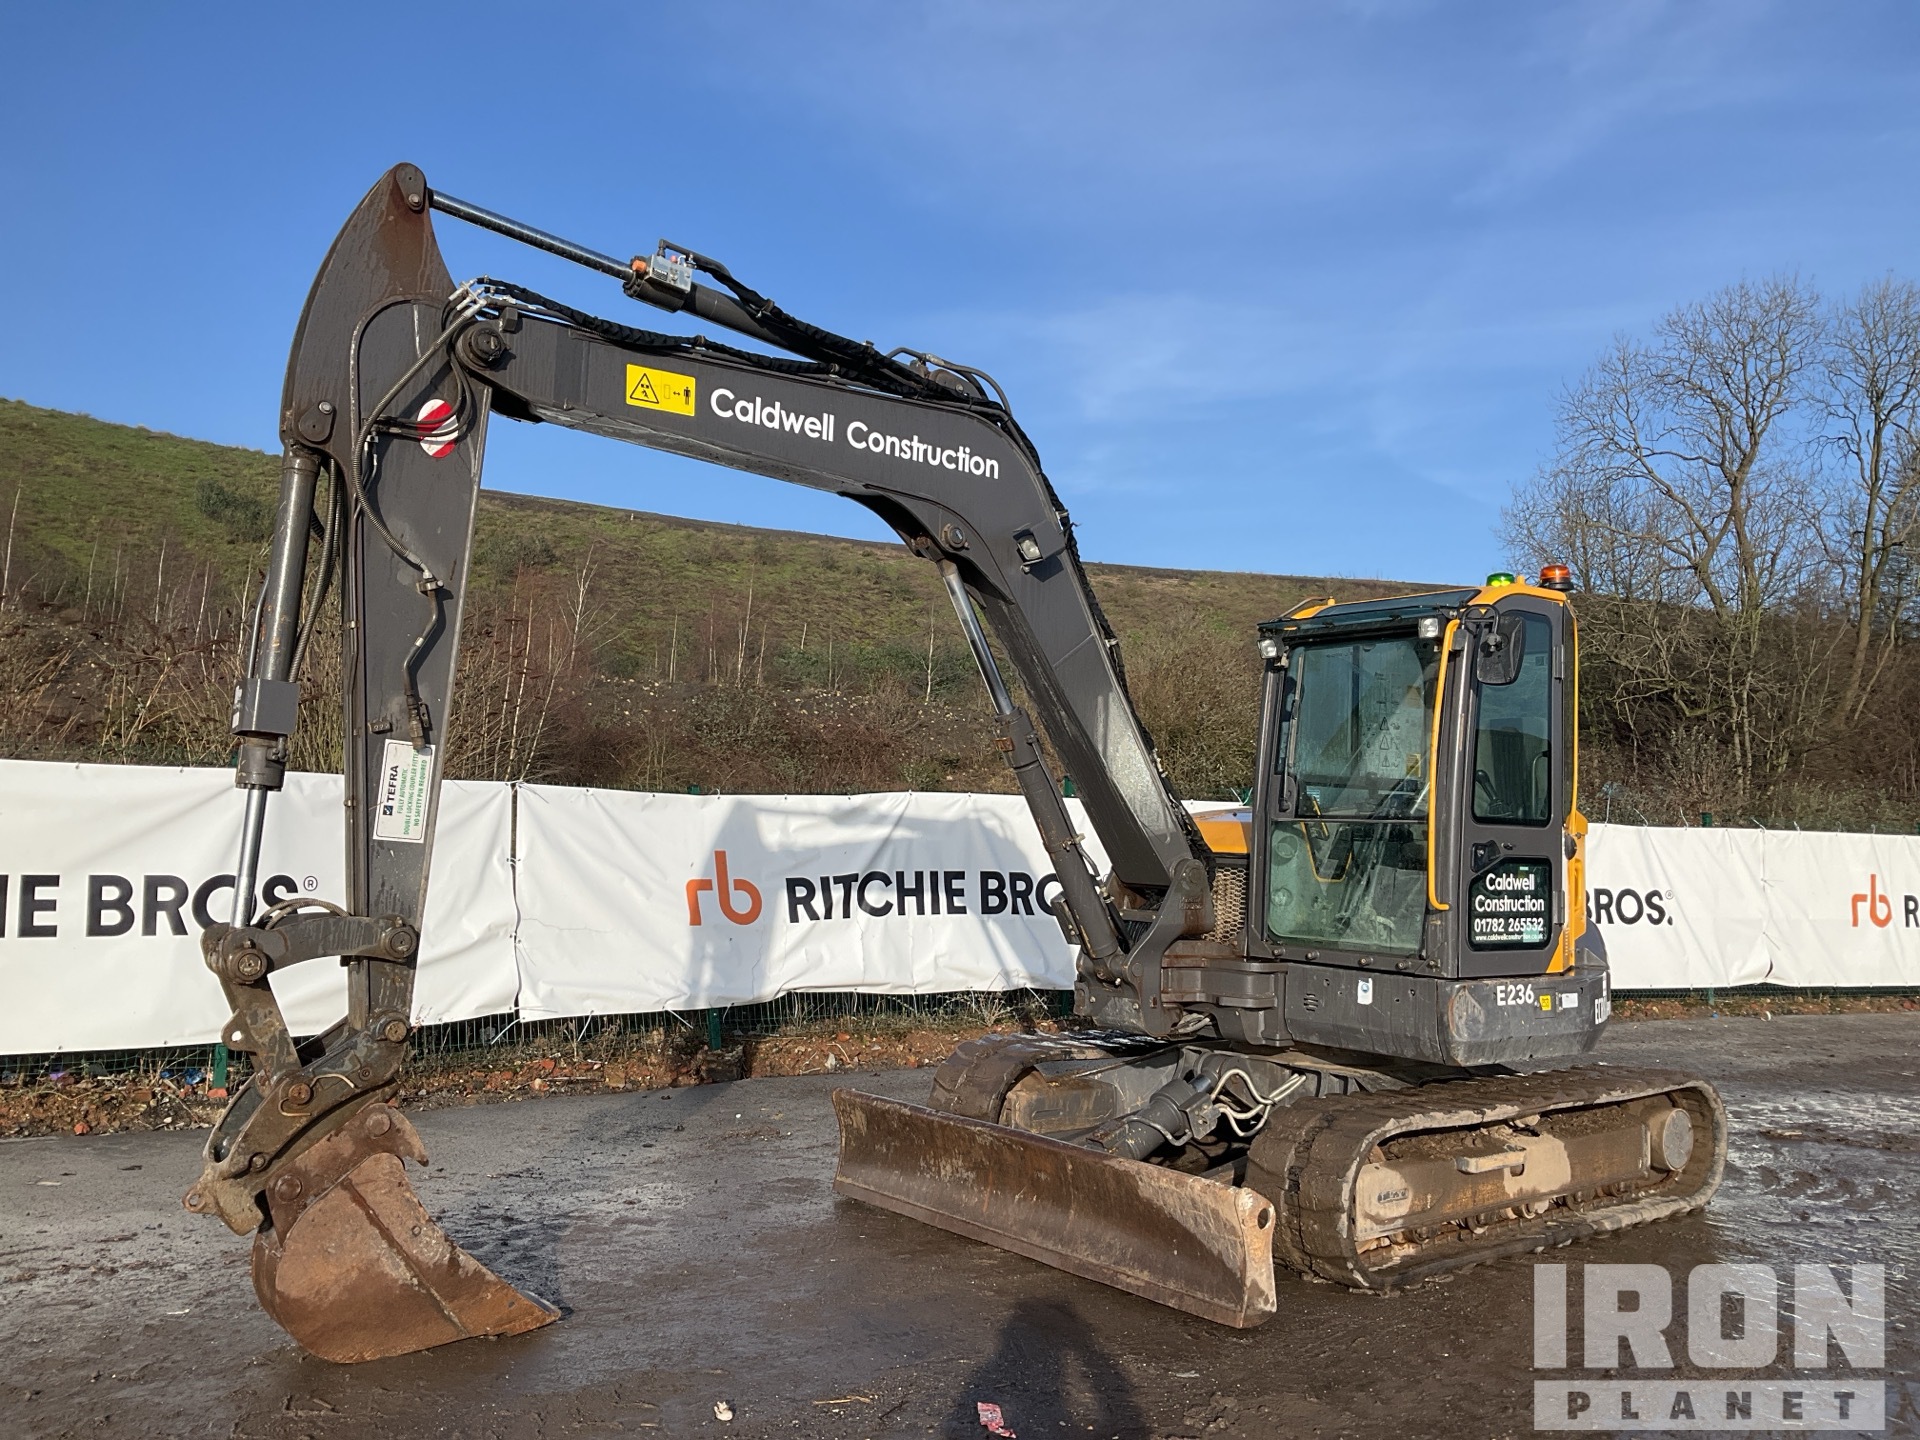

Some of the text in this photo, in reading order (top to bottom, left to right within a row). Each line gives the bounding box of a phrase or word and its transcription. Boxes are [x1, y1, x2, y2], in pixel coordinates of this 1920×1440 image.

[710, 388, 999, 479] Caldwell Construction
[386, 765, 399, 803] TEFRA
[408, 768, 417, 791] COUPLER
[418, 759, 427, 787] REQUIRED
[397, 768, 408, 814] FULLY AUTOMATIC
[405, 791, 414, 814] LOCKING
[414, 798, 422, 817] SAFETY
[402, 814, 412, 835] DOUBLE
[413, 818, 420, 826] NO
[1485, 873, 1535, 890] Caldwell
[785, 870, 967, 923] RITCHIE
[1475, 895, 1545, 912] Construction
[1474, 917, 1544, 932] 01782 265532
[1496, 984, 1535, 1006] E236
